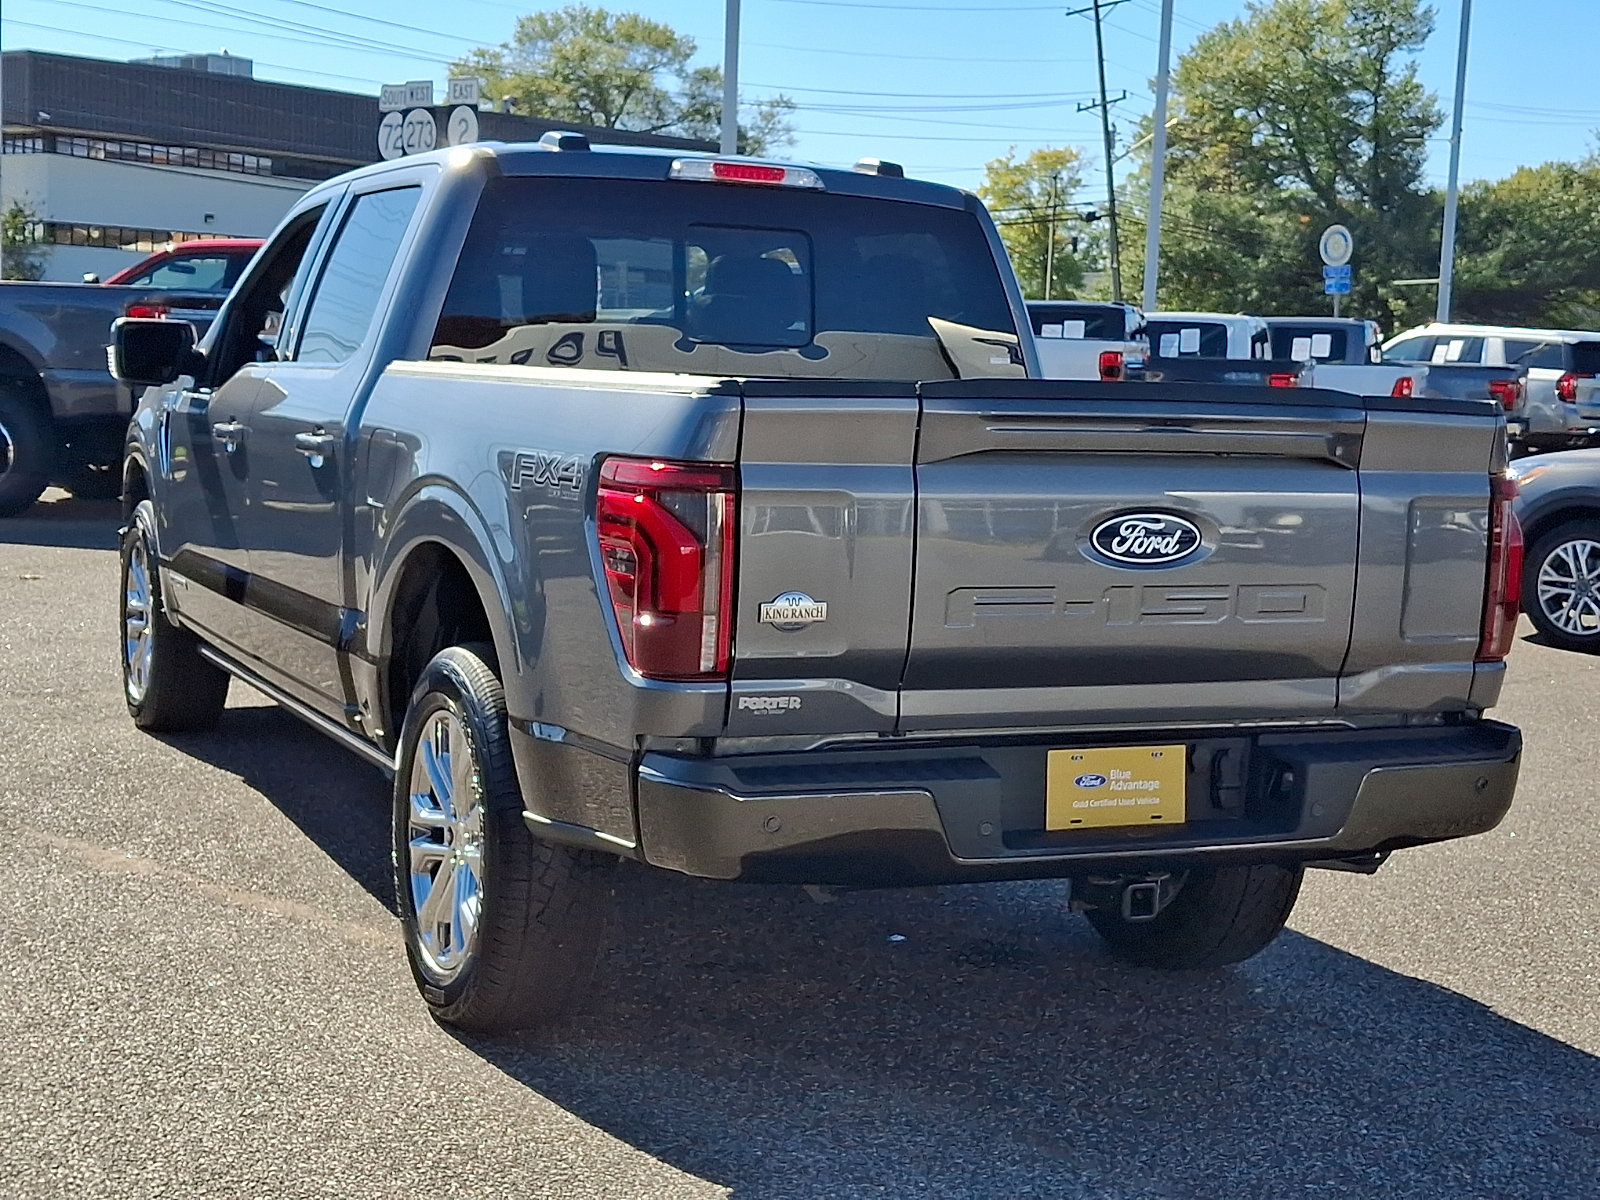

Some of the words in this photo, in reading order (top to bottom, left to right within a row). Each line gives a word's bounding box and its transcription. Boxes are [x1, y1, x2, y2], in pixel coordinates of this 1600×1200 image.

[383, 89, 407, 106] SOUT
[409, 85, 431, 102] WEST
[453, 83, 474, 100] EAST
[406, 120, 434, 148] 273
[458, 118, 470, 144] 2
[510, 447, 584, 492] FX4
[1112, 521, 1182, 555] Ford
[765, 606, 789, 620] KING
[791, 605, 824, 619] RANCH
[945, 584, 1327, 628] F-150
[738, 696, 801, 710] PORTER
[1079, 774, 1102, 787] Ford
[1110, 769, 1132, 780] Blue
[1109, 780, 1160, 792] Advantage
